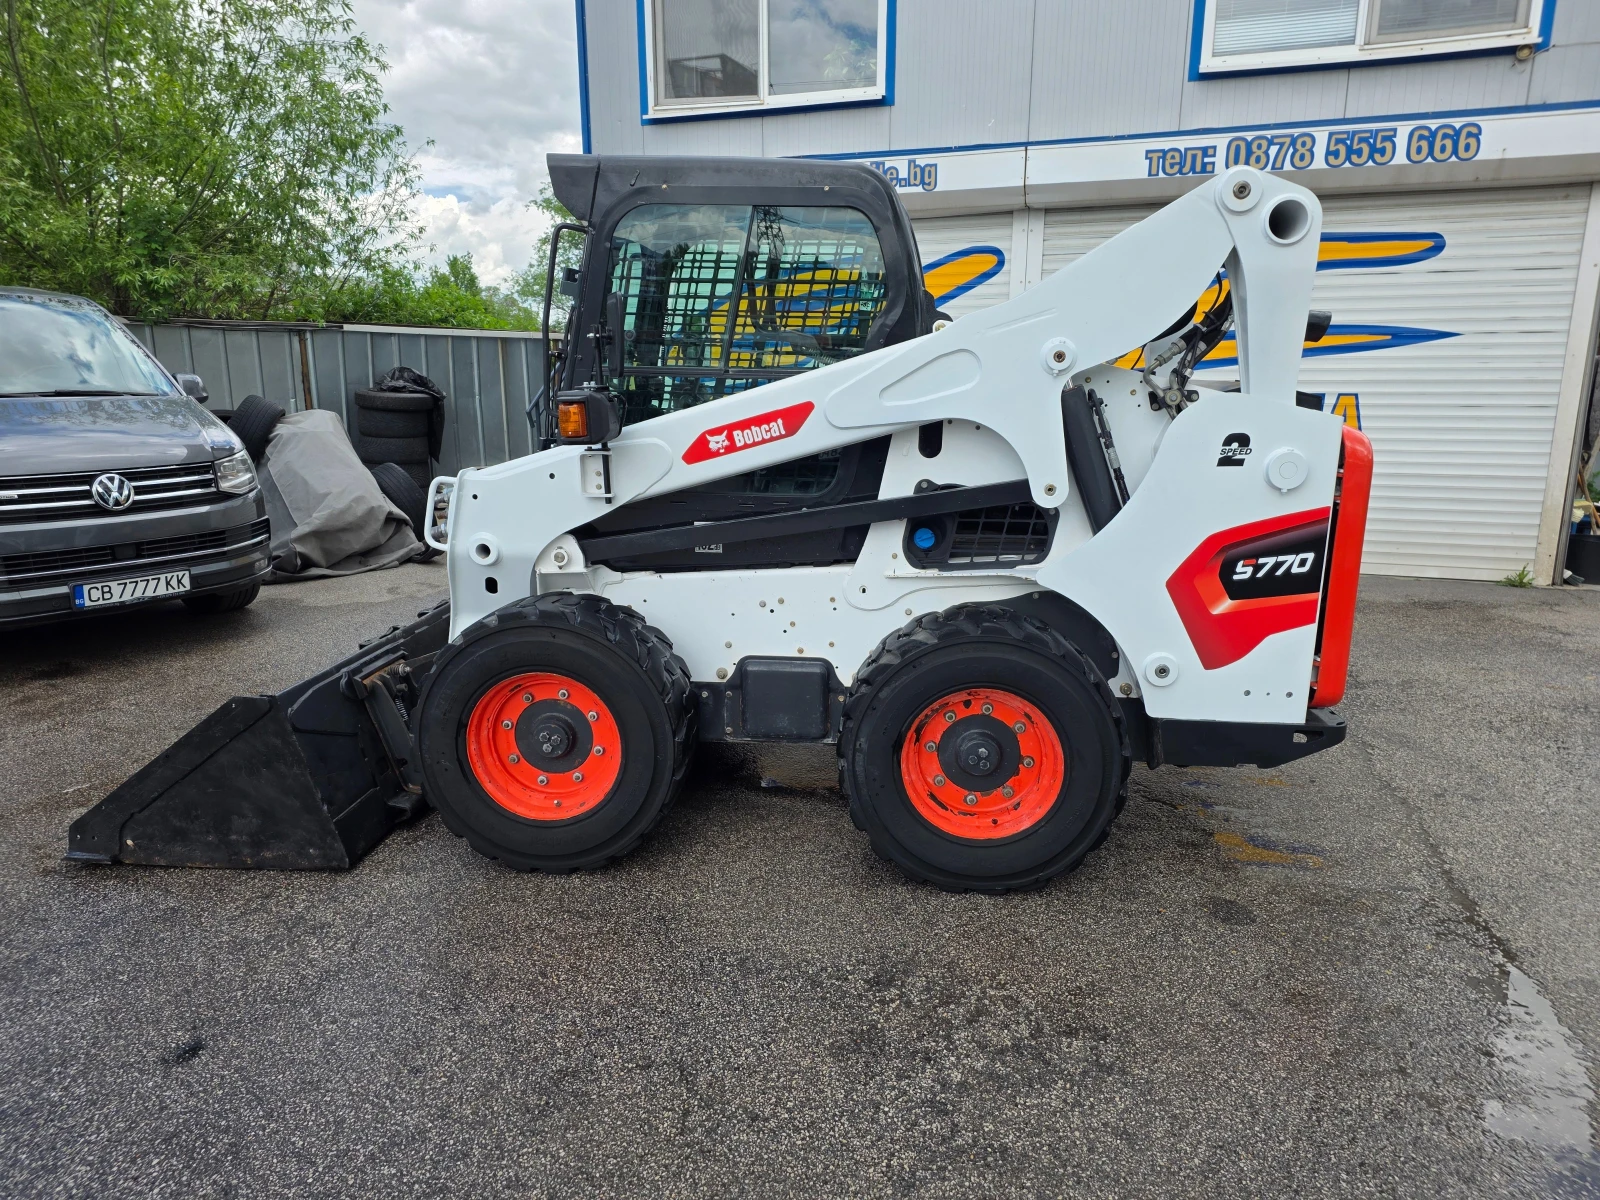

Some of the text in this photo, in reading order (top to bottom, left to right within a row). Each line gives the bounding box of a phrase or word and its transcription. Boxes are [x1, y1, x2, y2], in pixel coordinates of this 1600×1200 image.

[1145, 122, 1483, 178] тел: 0878 555 666
[870, 159, 938, 192] e.bg
[732, 417, 786, 447] Bobcat
[1216, 432, 1251, 467] 2
[1219, 447, 1253, 456] SPEED
[1232, 552, 1315, 580] S770
[87, 584, 113, 603] CB
[117, 576, 161, 600] 7777
[165, 572, 187, 592] KK
